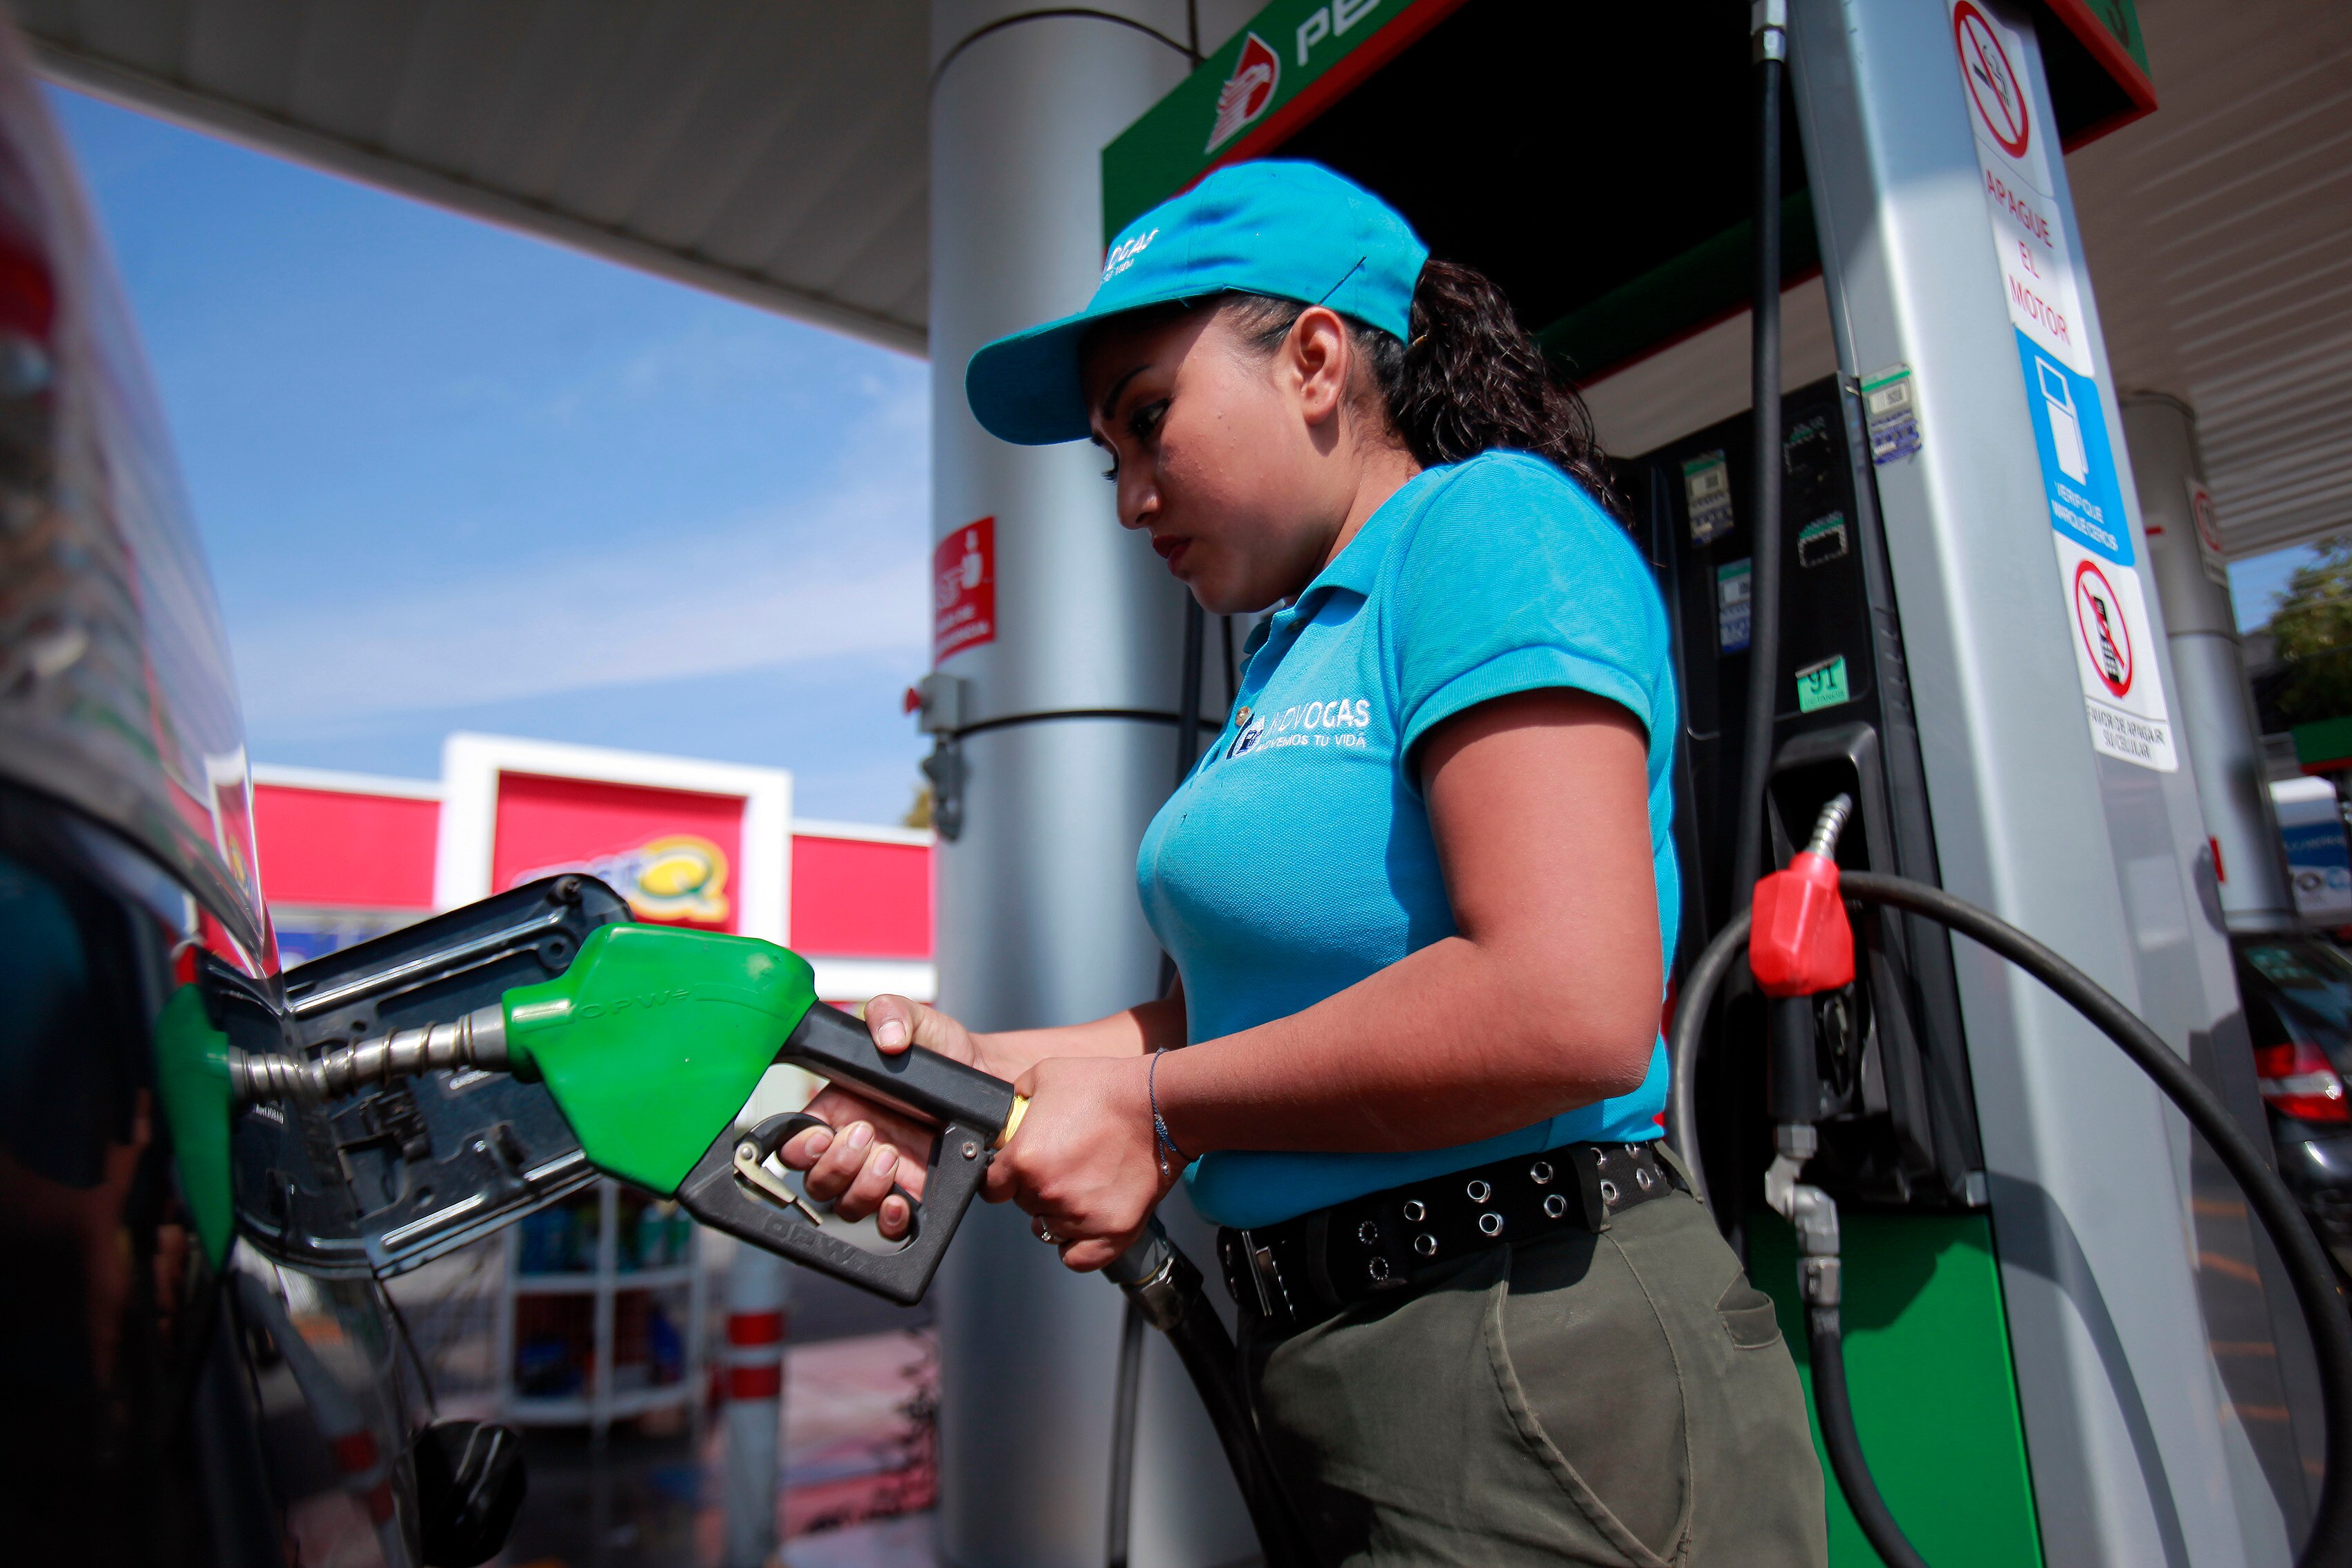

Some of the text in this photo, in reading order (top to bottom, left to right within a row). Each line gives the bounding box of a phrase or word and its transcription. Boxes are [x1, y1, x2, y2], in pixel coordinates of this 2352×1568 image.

[1986, 169, 2053, 249] APAGUE
[1103, 227, 1159, 273] OGAS
[2017, 239, 2041, 279] EL
[2008, 274, 2072, 347] MOTOR
[1807, 665, 1837, 695] 91
[1263, 698, 1370, 739] NOVOGAS
[1315, 734, 1329, 746] TU
[1335, 734, 1366, 748] VIDA
[578, 989, 671, 1020] OPW
[760, 1211, 858, 1266] OPW
